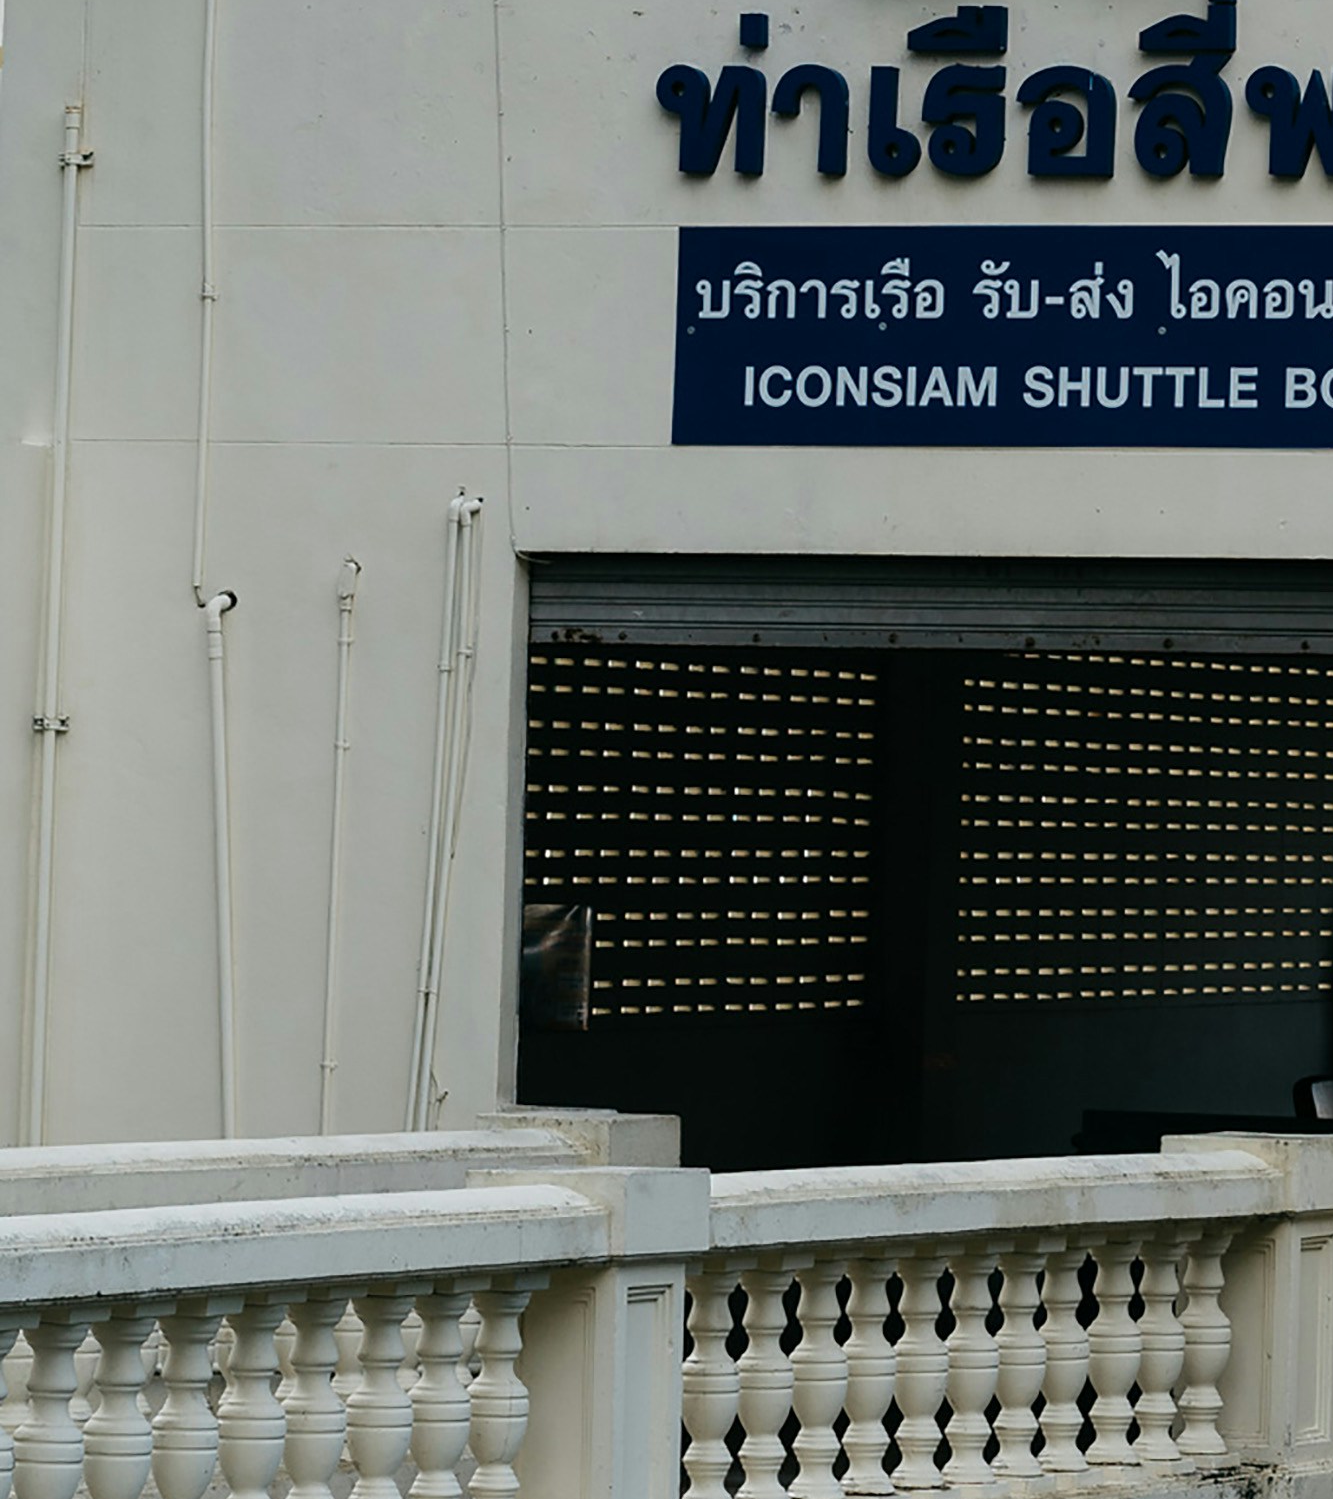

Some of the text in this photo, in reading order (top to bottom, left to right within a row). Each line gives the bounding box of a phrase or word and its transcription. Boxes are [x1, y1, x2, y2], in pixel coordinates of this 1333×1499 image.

[695, 257, 945, 320] บริการเรือ
[972, 259, 1134, 320] รับ-ส่ง
[744, 365, 999, 409] ICONSIAM
[1022, 365, 1259, 409] SHUTTLE
